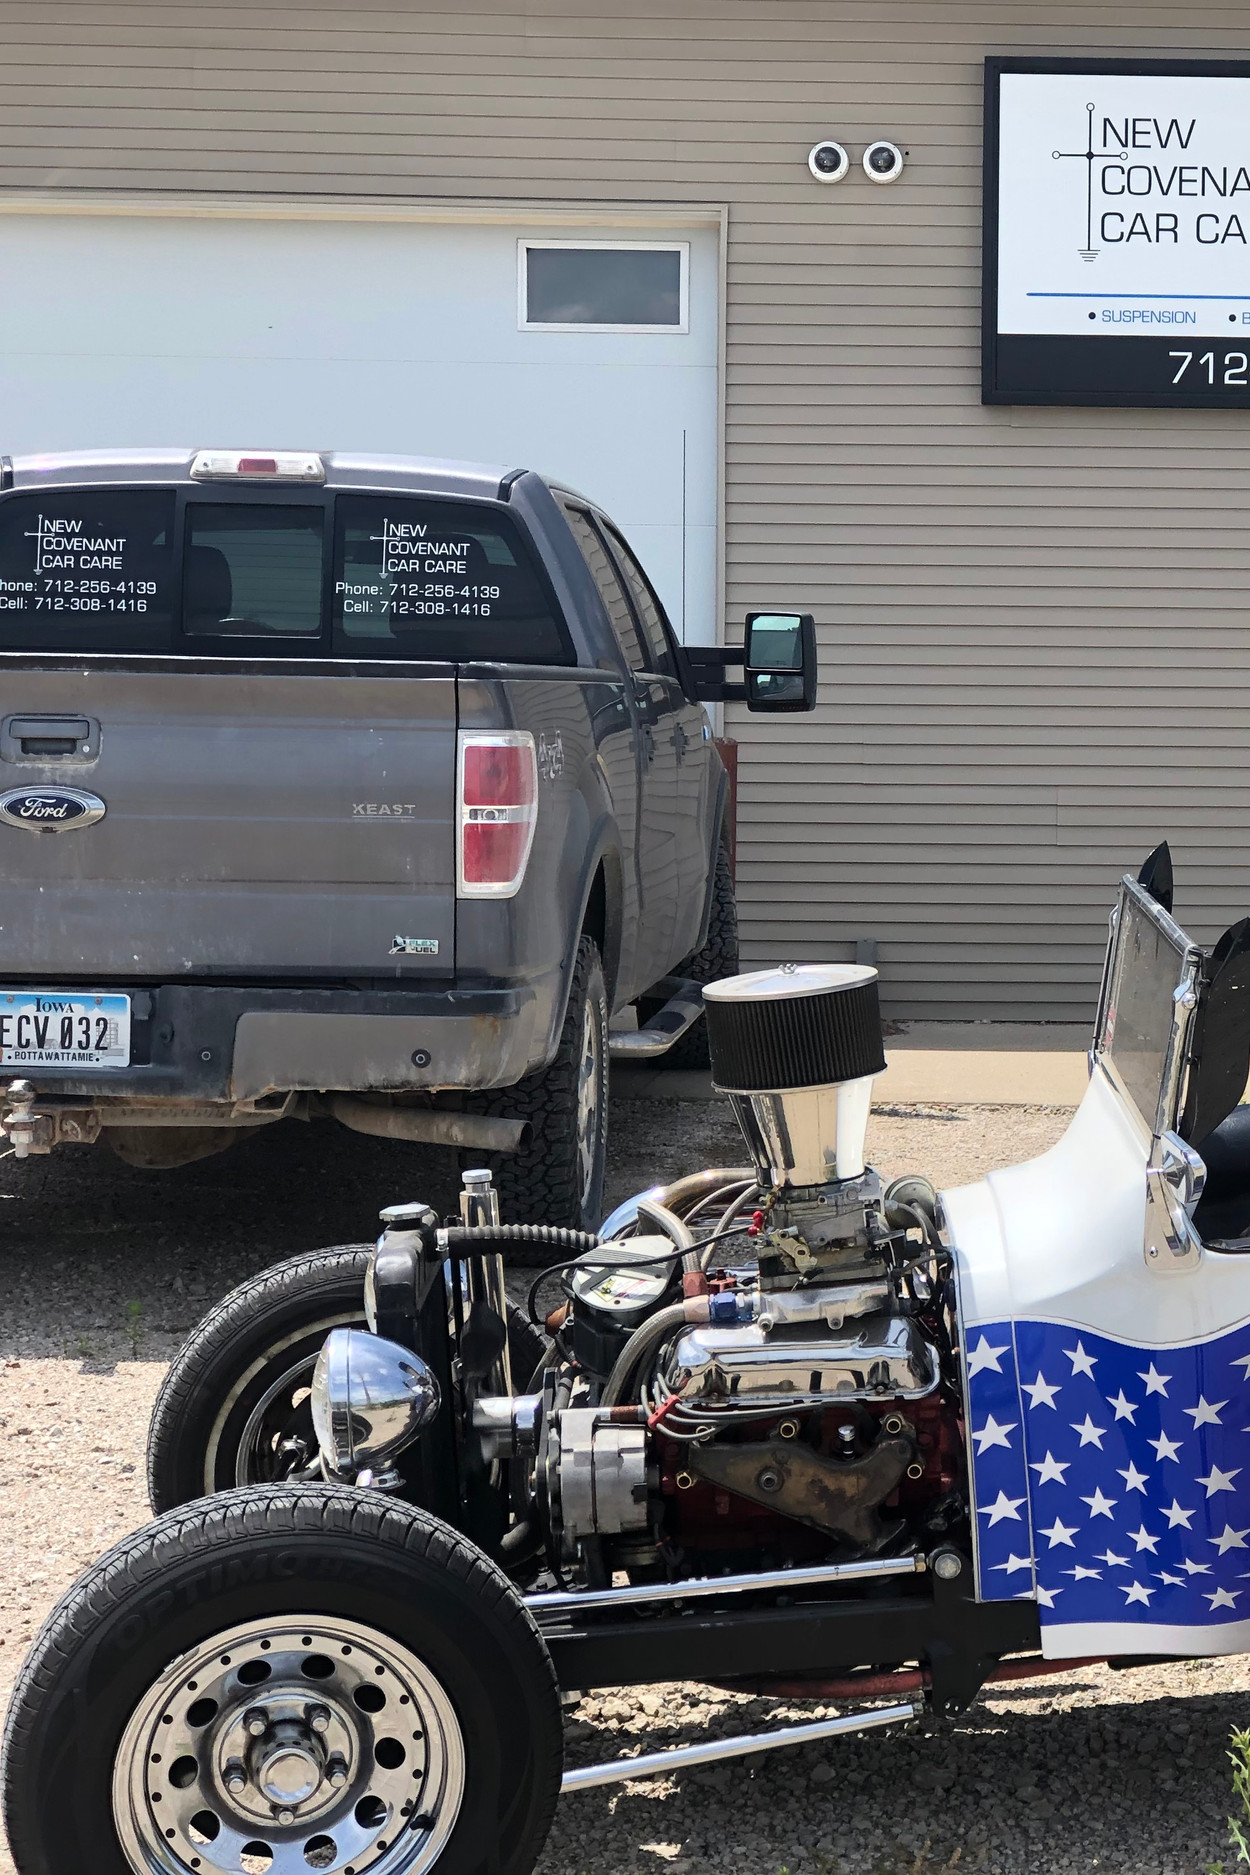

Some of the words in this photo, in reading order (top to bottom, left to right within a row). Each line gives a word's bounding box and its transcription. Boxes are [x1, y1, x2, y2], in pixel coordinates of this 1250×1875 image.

[1102, 117, 1197, 149] NEW
[1101, 211, 1179, 244] CAR
[1101, 309, 1197, 325] SUSPENSION
[44, 519, 83, 533] NEW
[389, 523, 427, 537] NEW
[43, 537, 126, 552] COVENANT
[388, 541, 470, 556] COVENANT
[42, 555, 75, 569] CAR
[80, 556, 123, 570] CARE
[387, 559, 420, 573] CAR
[424, 560, 467, 574] CARE
[0, 579, 38, 592] hone:
[44, 579, 157, 595] 712-256-4139
[335, 581, 383, 596] Phone:
[389, 583, 500, 599] 712-256-4139
[0, 596, 28, 610] Cell:
[34, 597, 147, 612] 712-308-1416
[343, 600, 374, 613] Cell:
[380, 601, 490, 616] 712-308-1416
[20, 797, 68, 818] Ford
[0, 1014, 50, 1049] ECV
[60, 1016, 108, 1051] 032
[14, 1051, 94, 1062] POTTAWATTAMIE
